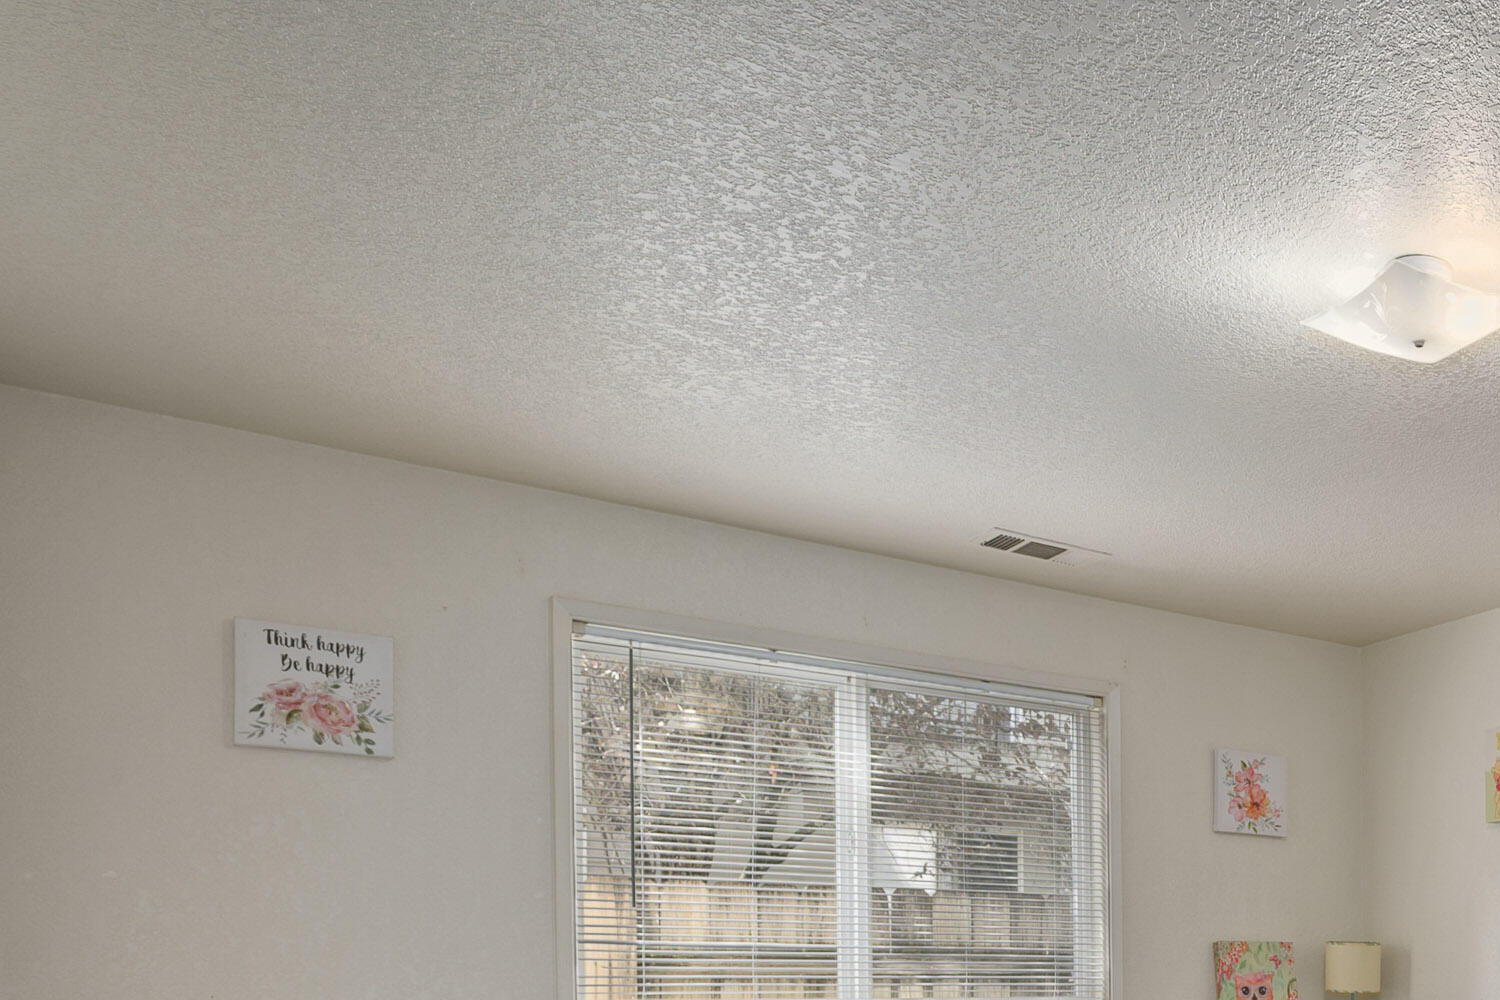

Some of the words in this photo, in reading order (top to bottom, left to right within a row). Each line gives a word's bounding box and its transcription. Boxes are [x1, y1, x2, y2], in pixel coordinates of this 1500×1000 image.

[263, 629, 313, 650] Think
[316, 635, 366, 663] happy
[280, 653, 301, 672] Be
[306, 656, 354, 683] happy
